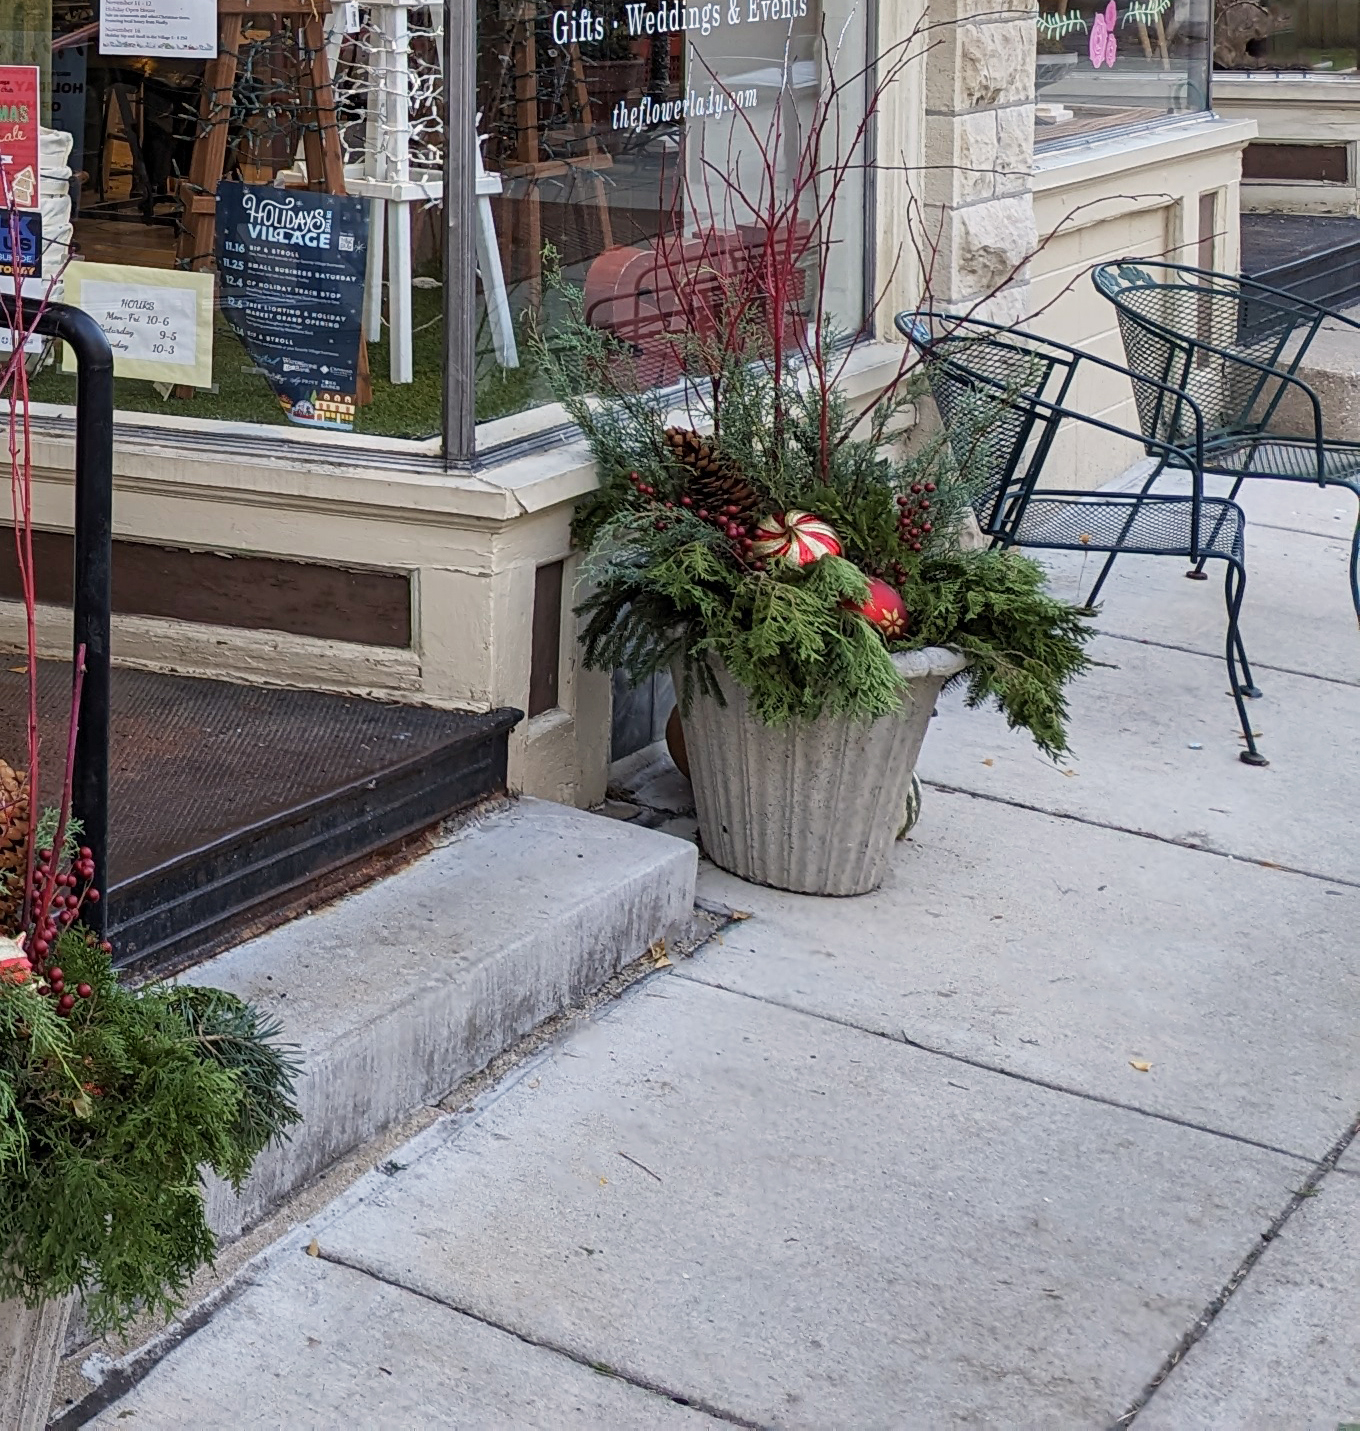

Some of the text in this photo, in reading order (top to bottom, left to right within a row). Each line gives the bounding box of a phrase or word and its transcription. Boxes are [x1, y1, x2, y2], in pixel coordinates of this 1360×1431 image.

[551, 8, 605, 46] Gifts
[611, 85, 759, 133] theflowerlady.com
[242, 193, 326, 235] HOLIDAYS
[2, 234, 33, 252] US
[247, 223, 331, 249] VILLAGE
[225, 241, 246, 254] 11.16
[271, 248, 299, 258] STROLL
[222, 257, 245, 271] 11.25
[248, 262, 272, 272] SMALL
[274, 266, 312, 278] BUSINESS
[314, 271, 357, 283] SATURDAY
[225, 274, 244, 289] 12.4
[258, 282, 292, 292] HOLIDAY
[120, 298, 155, 311] HOURS
[146, 315, 170, 327] 10-6
[304, 318, 340, 329] OPENING
[311, 312, 347, 323] HOLIDAY
[159, 330, 177, 341] 9-5
[109, 339, 175, 355] nday 10-3
